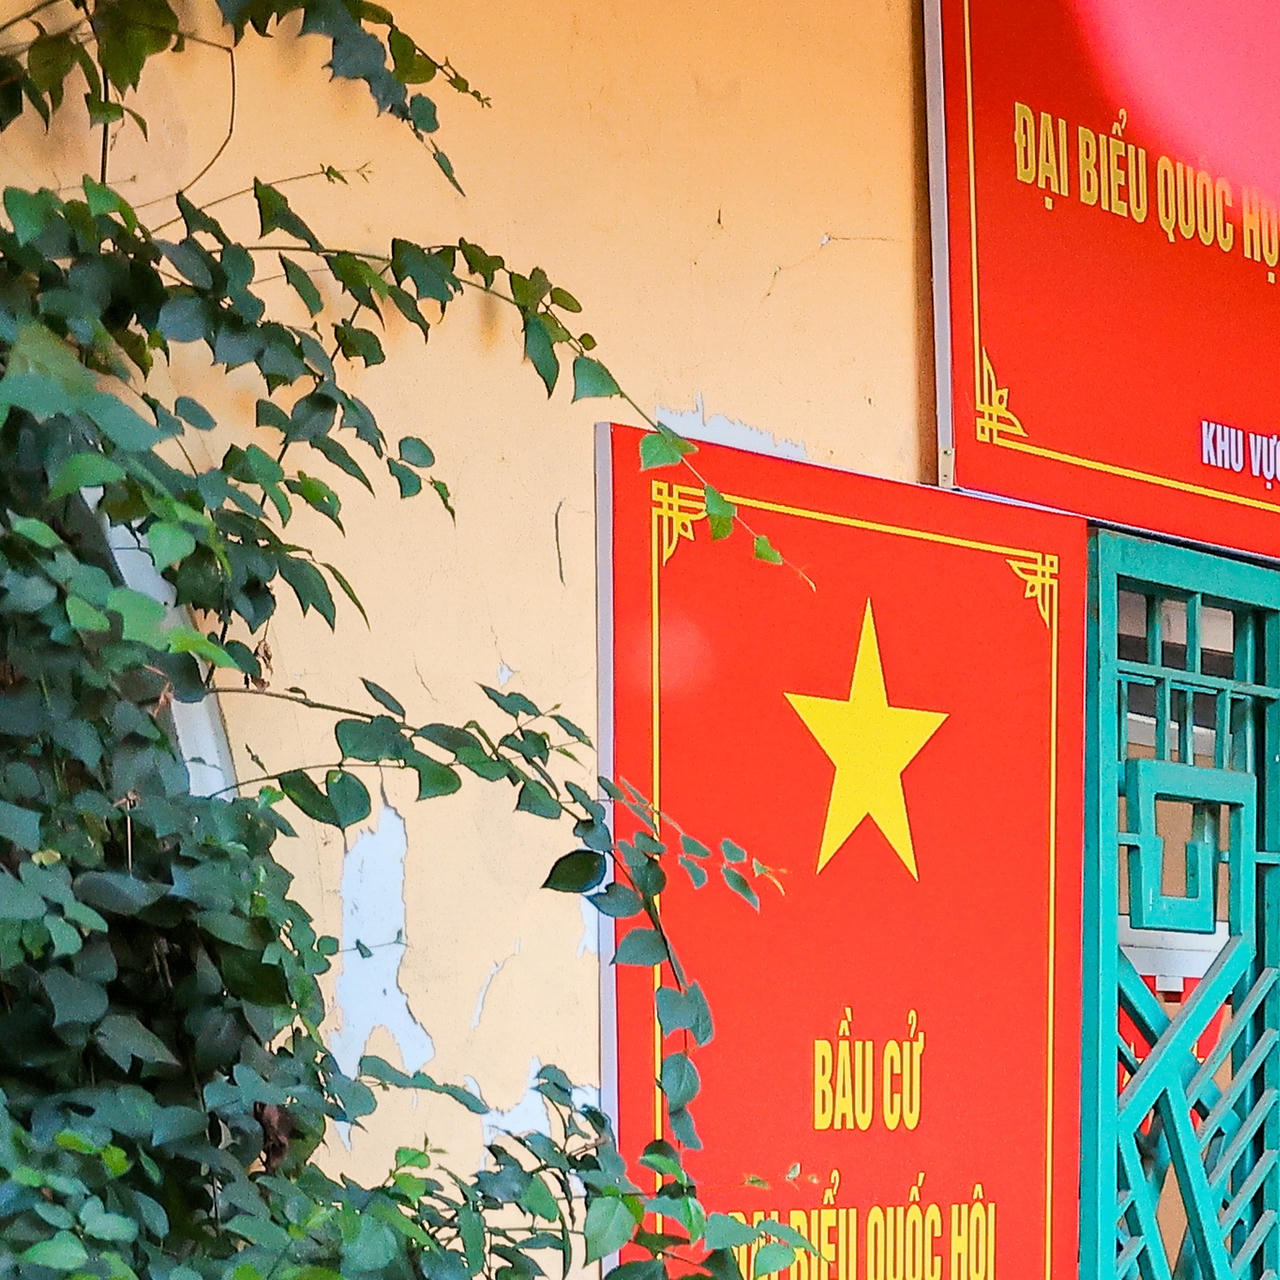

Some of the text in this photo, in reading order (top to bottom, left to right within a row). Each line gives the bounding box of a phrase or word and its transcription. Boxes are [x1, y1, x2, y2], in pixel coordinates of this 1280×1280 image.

[1014, 101, 1069, 211] ĐẠI
[1078, 108, 1148, 224] BIỂU
[1201, 420, 1244, 472] KHU
[813, 1007, 925, 1131] BẦU CỬ
